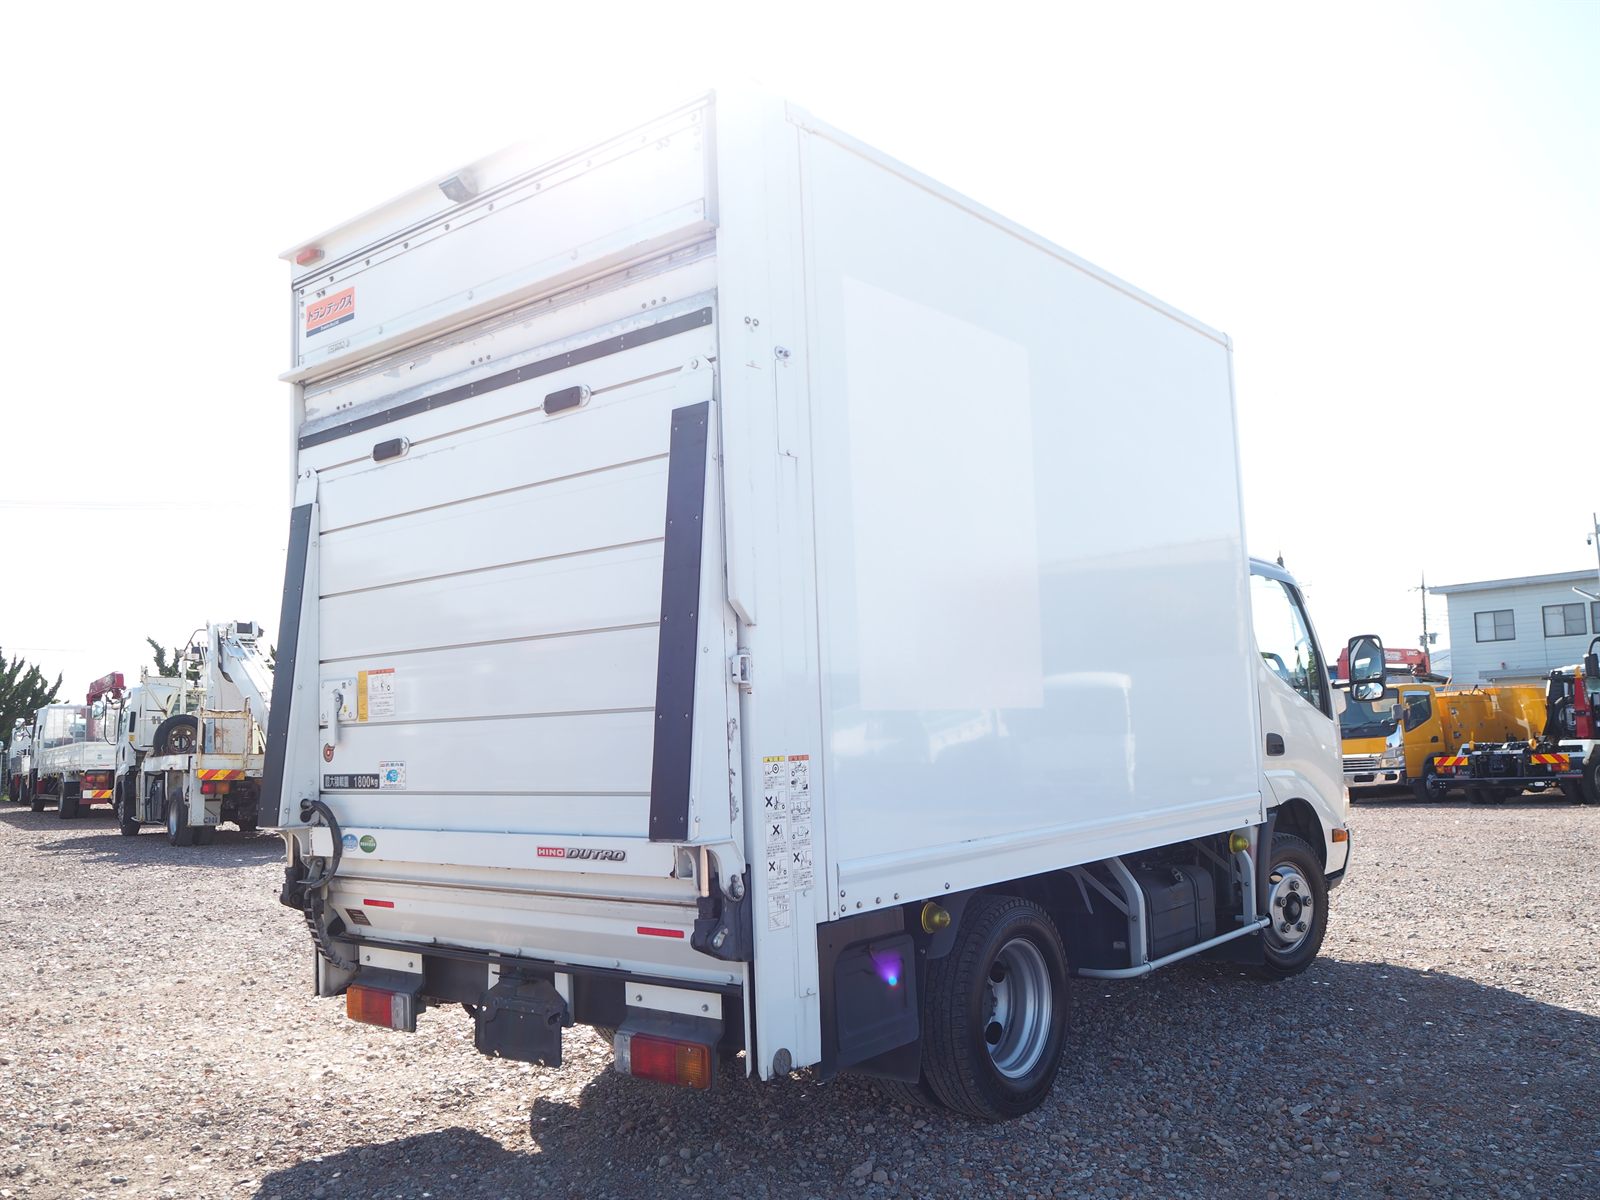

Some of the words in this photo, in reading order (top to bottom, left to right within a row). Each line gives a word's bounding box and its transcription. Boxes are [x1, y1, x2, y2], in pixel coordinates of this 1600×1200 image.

[307, 294, 353, 323] トランテックス
[353, 775, 379, 788] 1800kg
[537, 848, 564, 857] HINO
[566, 848, 626, 862] DUTRO
